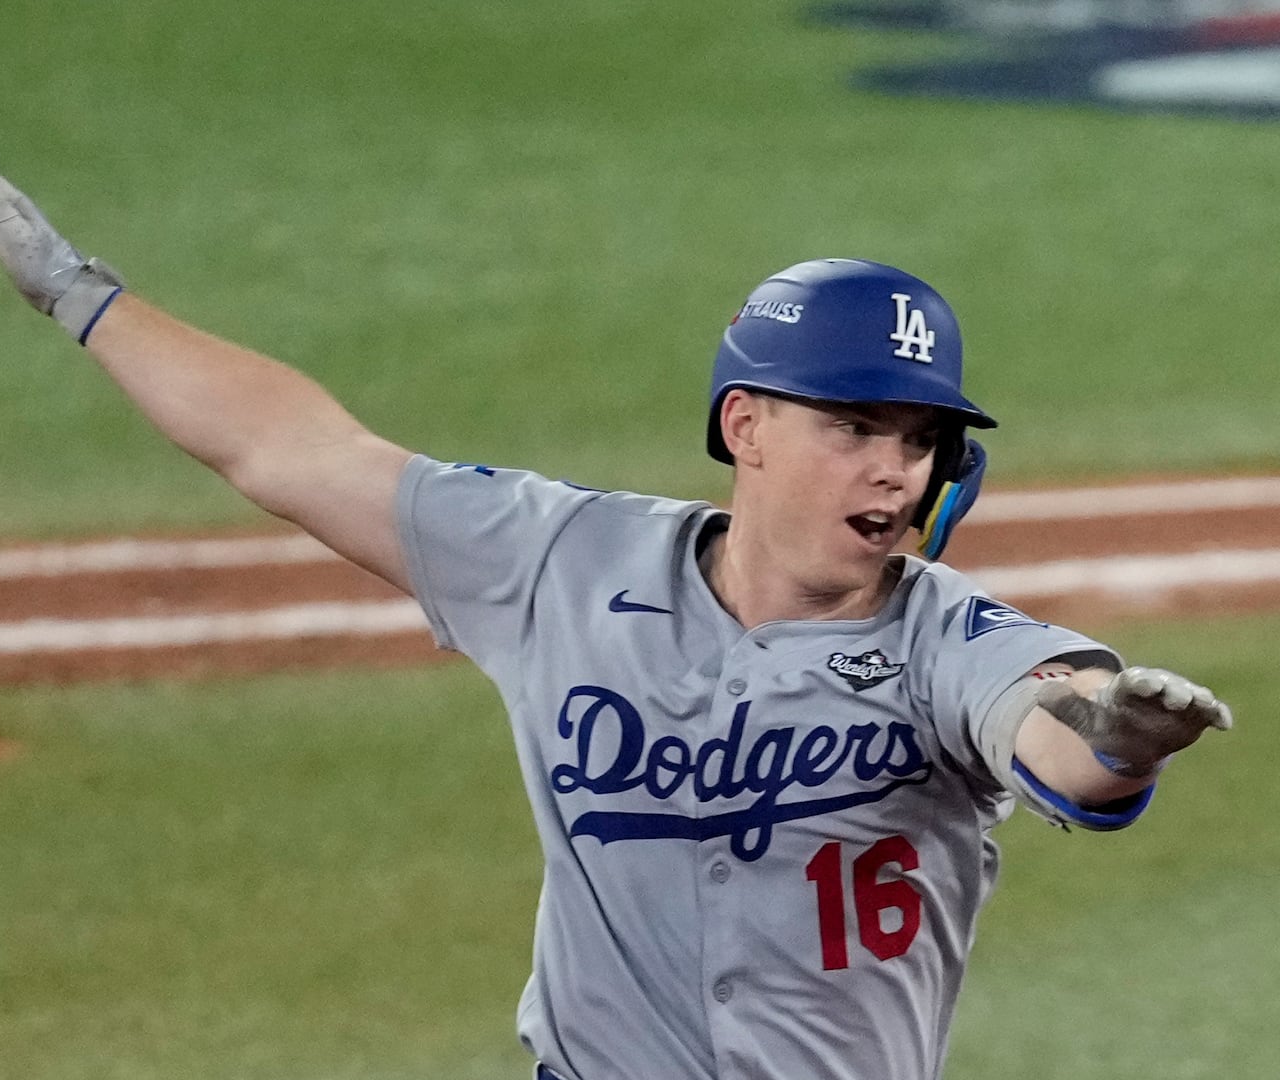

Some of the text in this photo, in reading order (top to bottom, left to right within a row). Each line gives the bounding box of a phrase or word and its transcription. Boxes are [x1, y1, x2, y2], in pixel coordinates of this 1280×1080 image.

[890, 293, 935, 363] LA
[552, 685, 931, 862] Dodgers
[806, 835, 920, 971] 16
